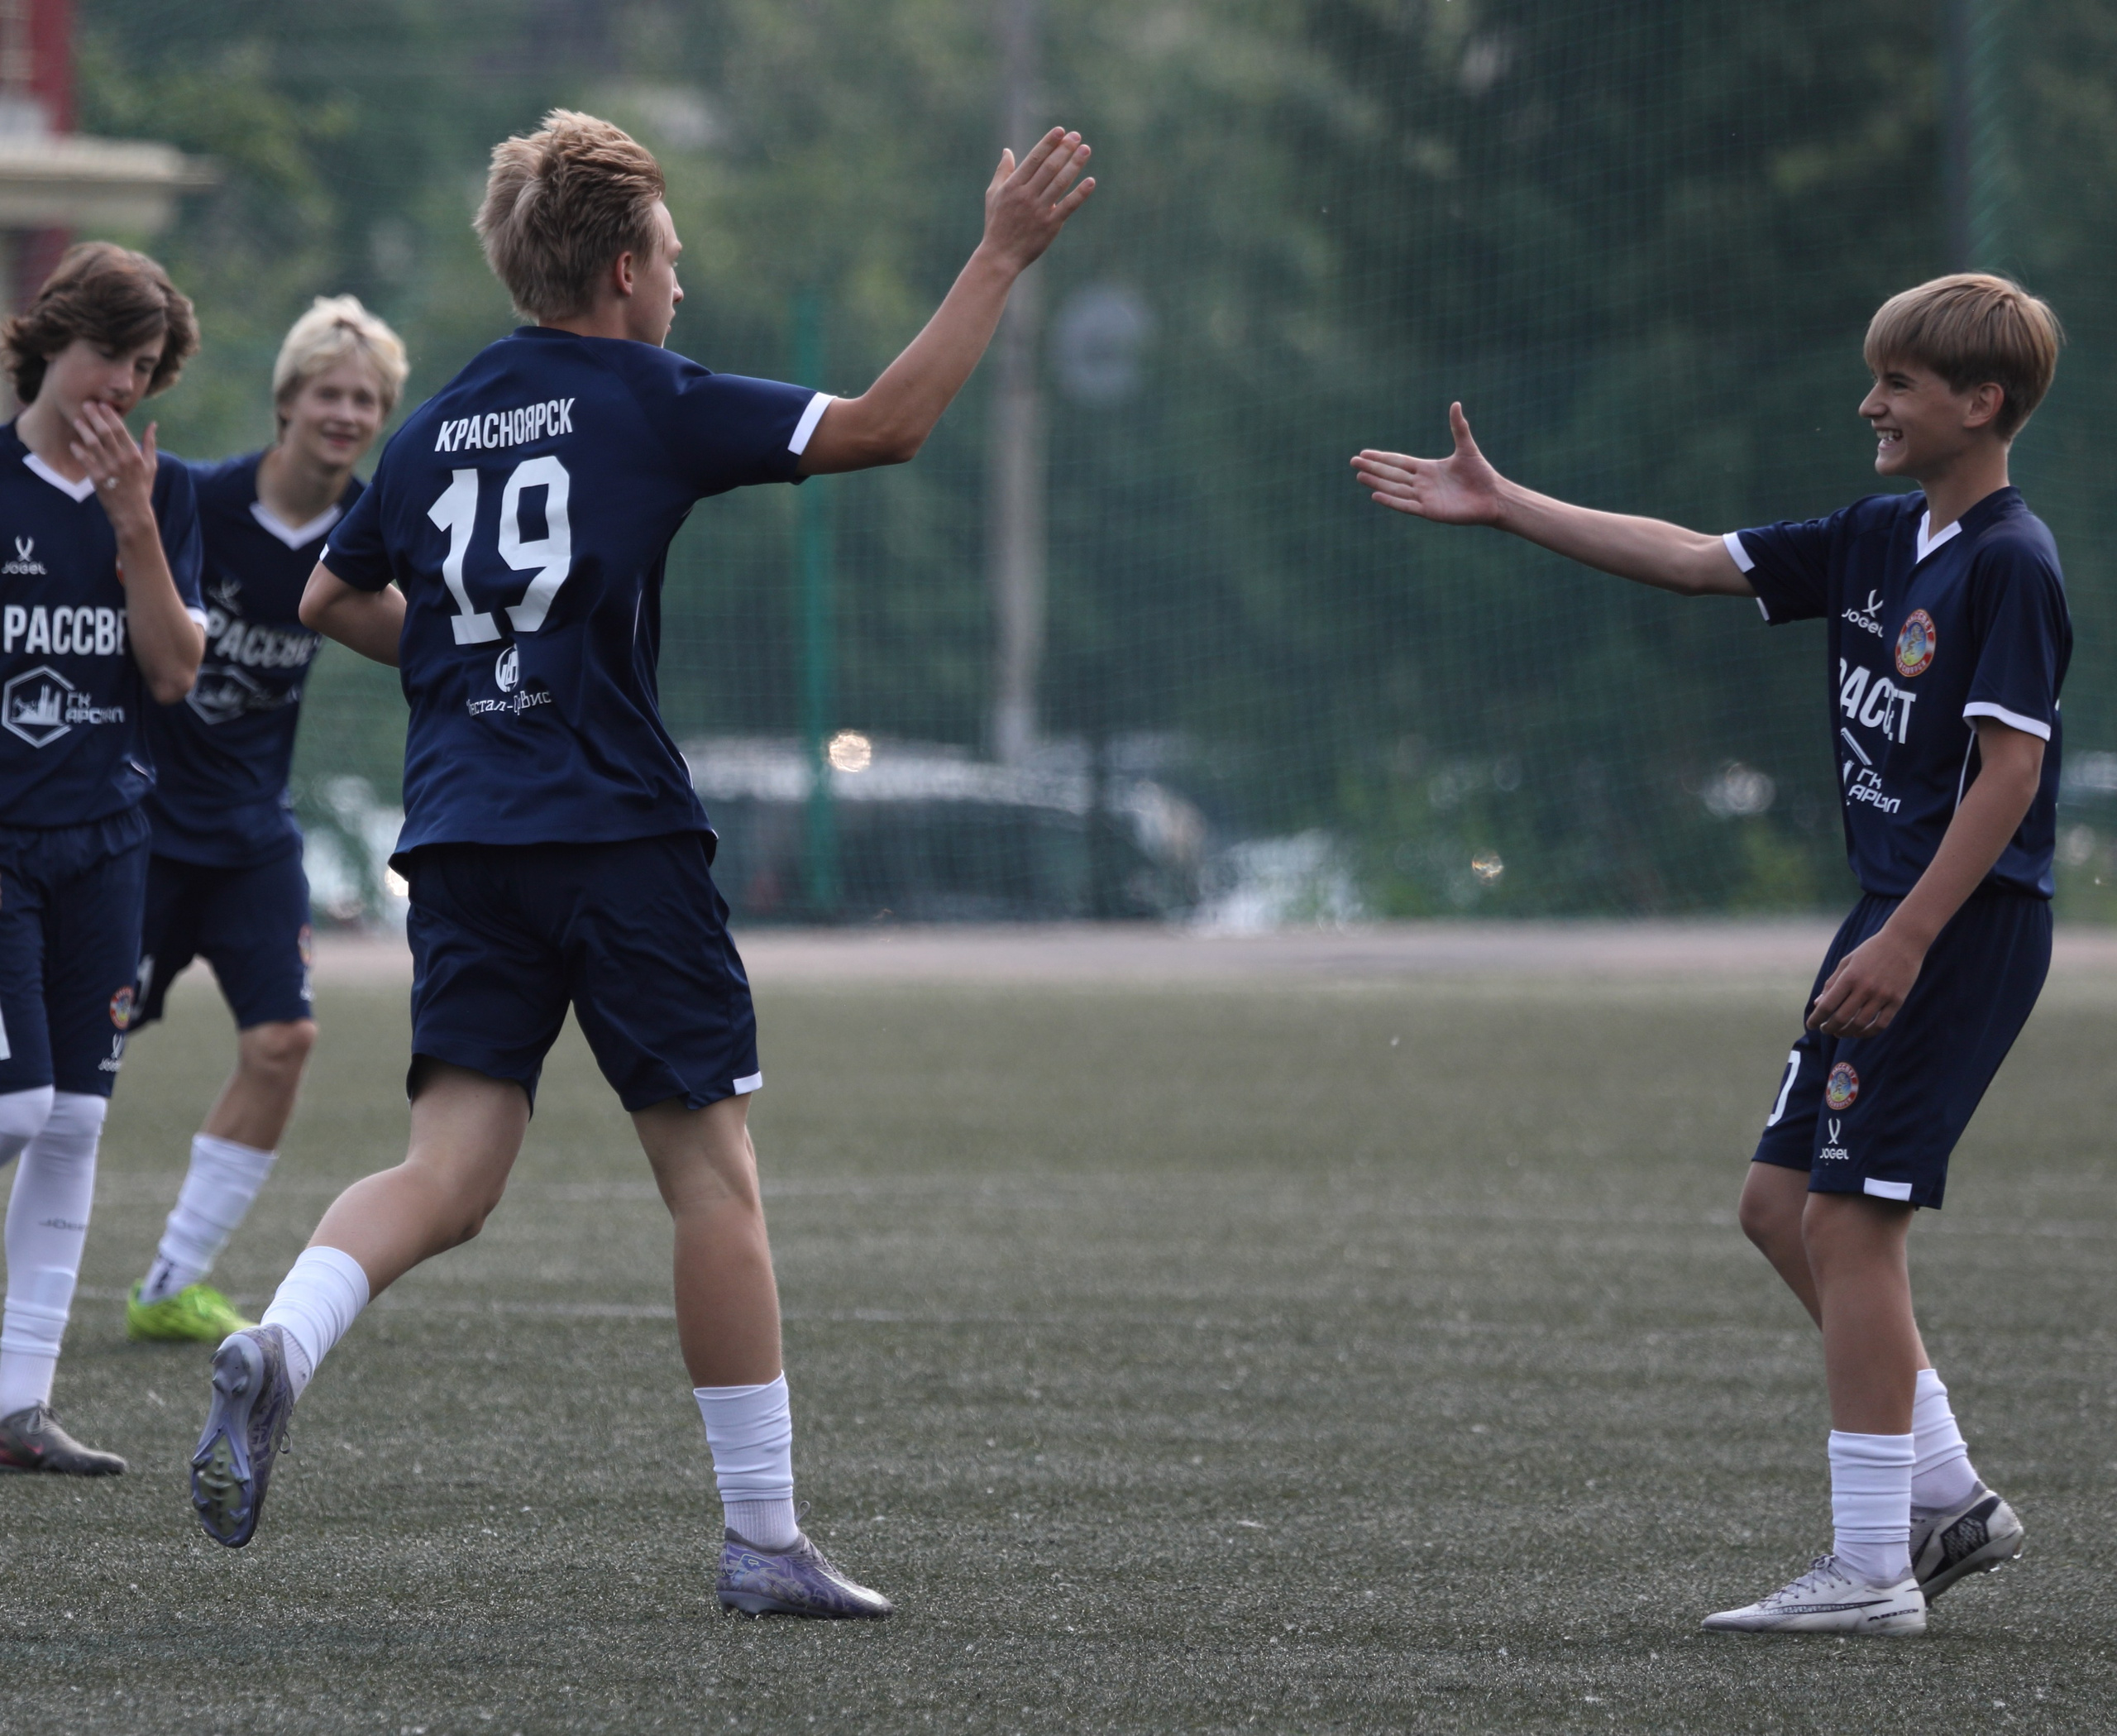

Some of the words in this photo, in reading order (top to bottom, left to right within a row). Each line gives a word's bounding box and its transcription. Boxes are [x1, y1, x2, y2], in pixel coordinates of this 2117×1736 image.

[434, 398, 576, 452] КРАСНОЯРСК
[427, 455, 571, 645] 19
[1857, 768, 1882, 790] ГК
